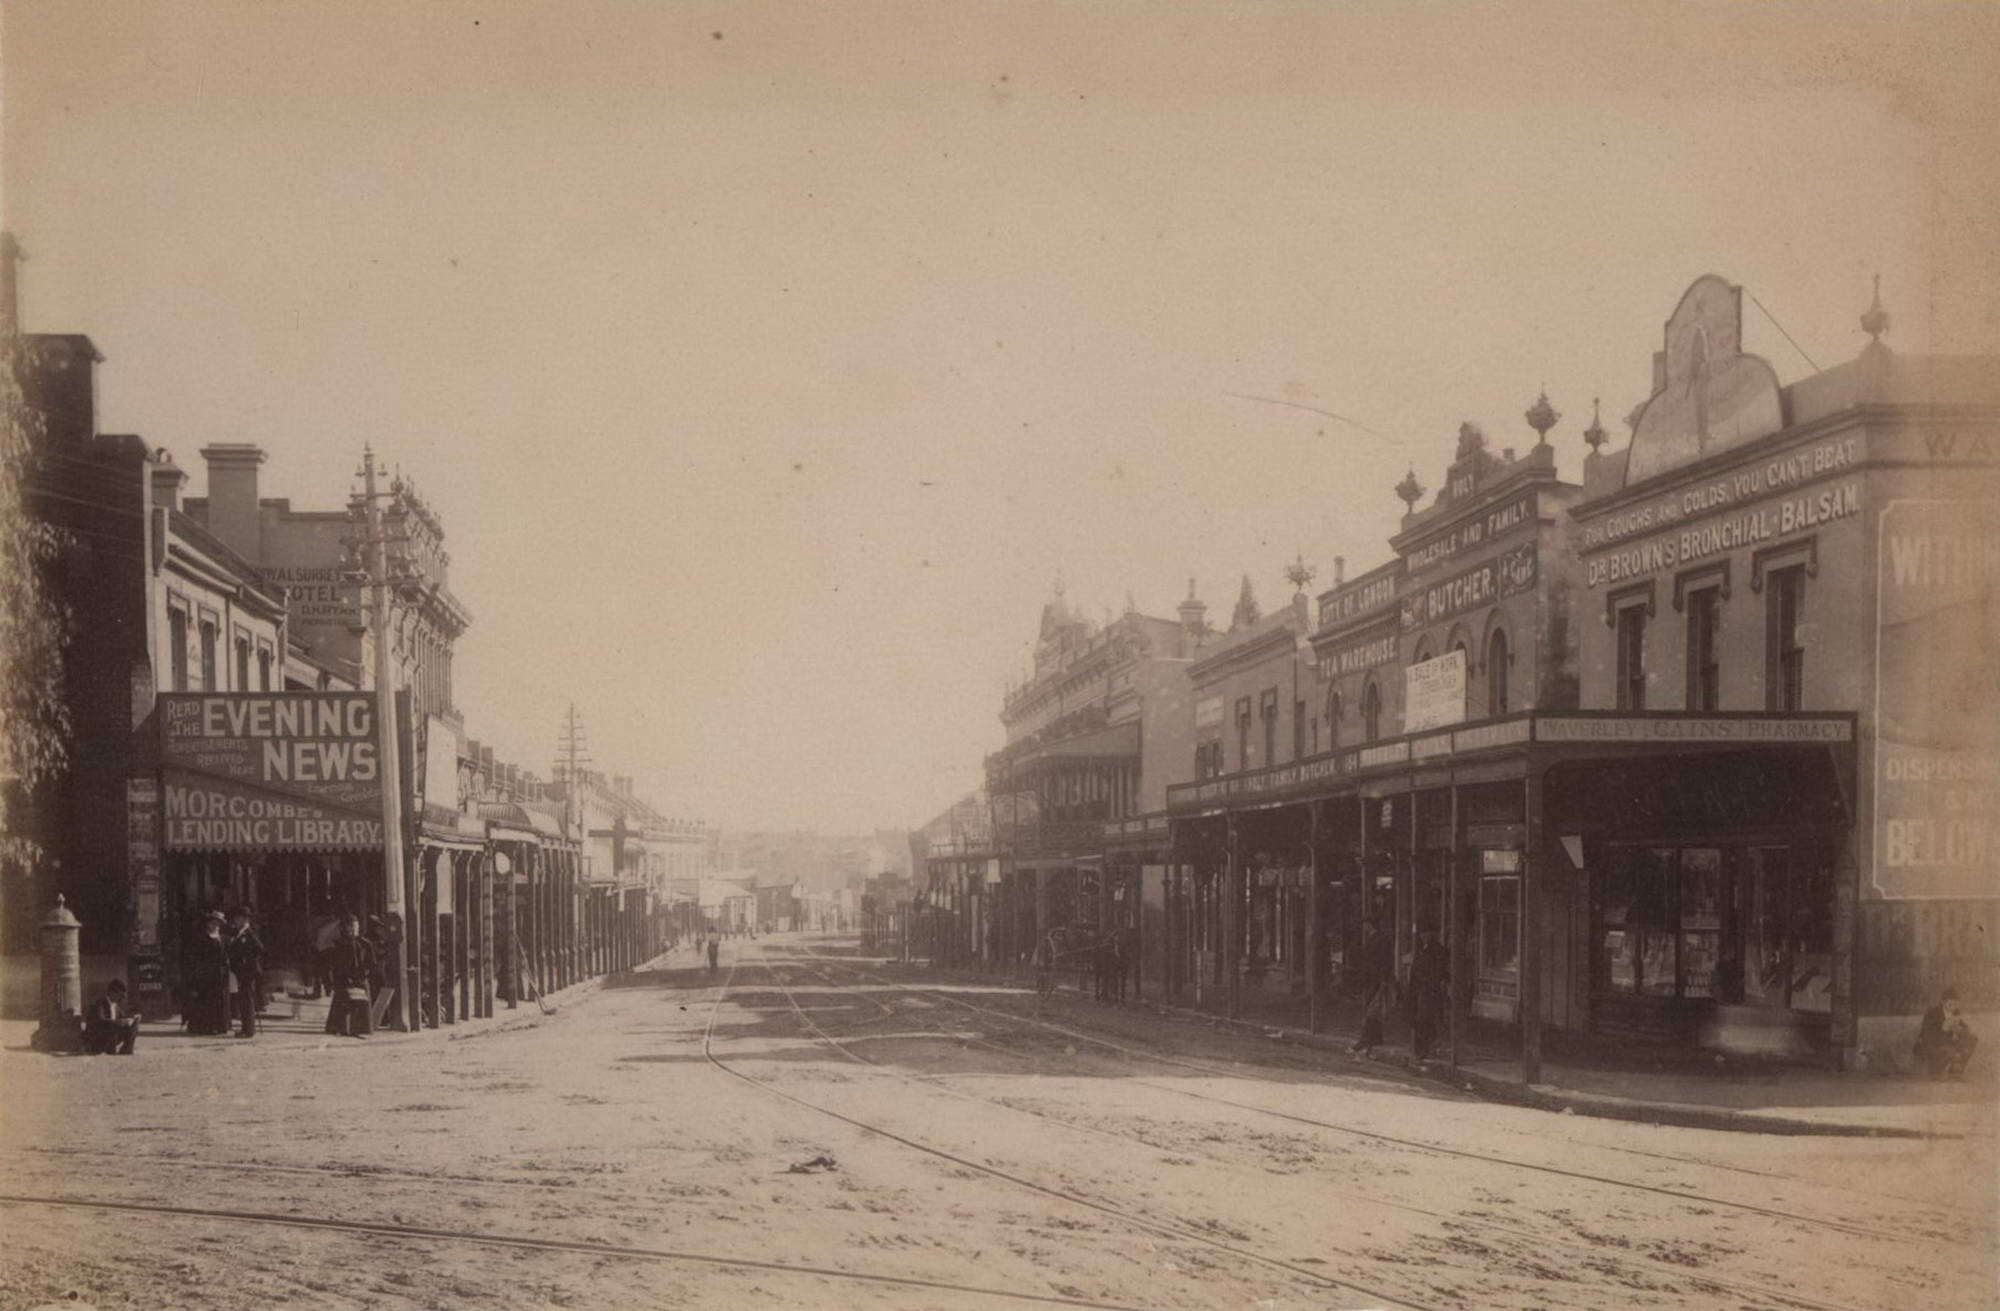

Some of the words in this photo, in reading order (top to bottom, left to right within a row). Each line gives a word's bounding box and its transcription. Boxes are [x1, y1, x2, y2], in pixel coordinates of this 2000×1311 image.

[1607, 507, 1652, 539] COUGHS
[1734, 471, 1760, 498] YOU
[1814, 439, 1856, 473] BEAT
[1610, 537, 1675, 581] BROWN'S
[1680, 511, 1771, 561] BRONCHIAL
[166, 700, 200, 721] READ
[202, 697, 371, 738] EVENING
[1542, 720, 1642, 738] WAVERLEY
[1747, 720, 1844, 738] PHARMACY
[172, 720, 201, 737] THE
[262, 738, 377, 782] NEWS
[167, 819, 270, 845] LENDING
